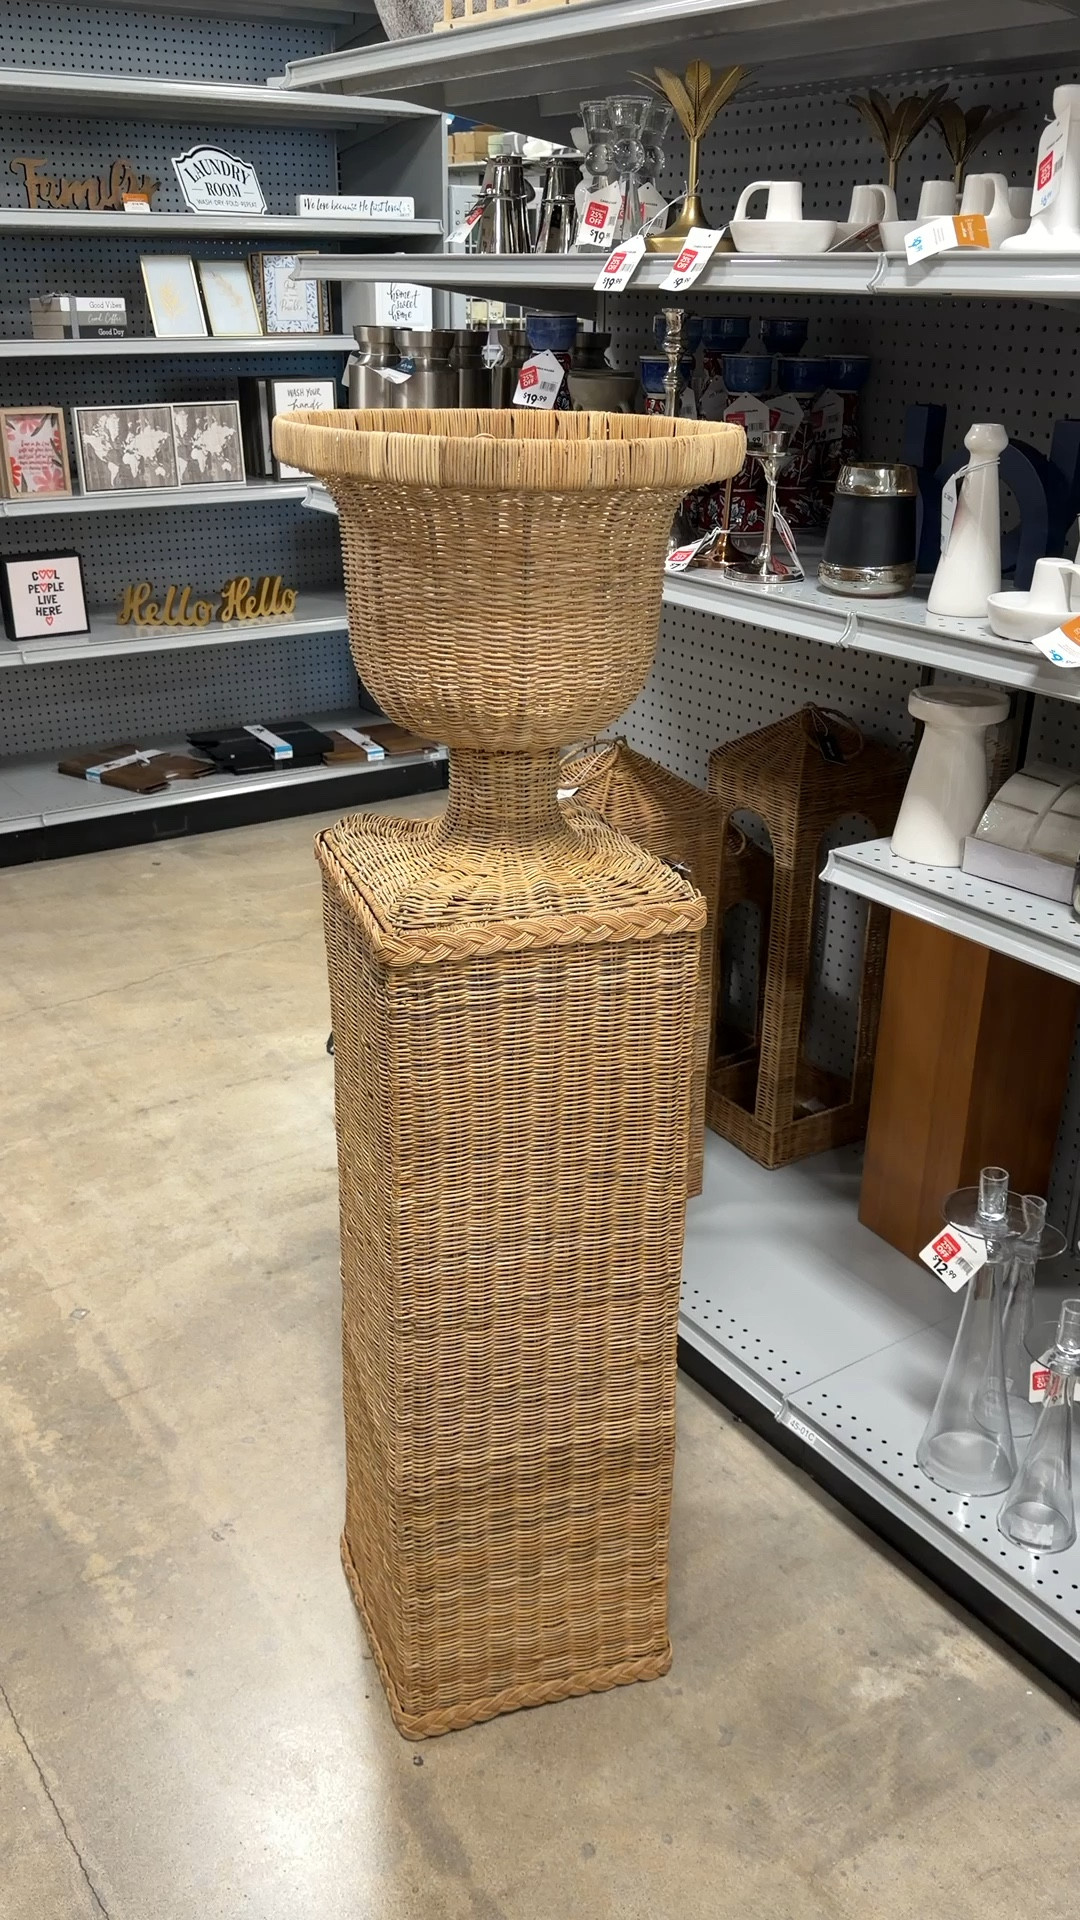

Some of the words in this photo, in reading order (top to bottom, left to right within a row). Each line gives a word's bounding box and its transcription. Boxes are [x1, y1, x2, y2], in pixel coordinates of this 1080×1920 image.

[184, 159, 250, 185] LAUNDRY
[205, 182, 242, 197] ROOM
[303, 198, 315, 210] We
[359, 200, 368, 211] He
[589, 217, 602, 225] OFF
[590, 210, 604, 219] 25%
[387, 282, 413, 302] home
[89, 301, 104, 309] Good
[105, 300, 122, 309] Vibes
[396, 290, 420, 309] sweet
[388, 304, 412, 321] home
[97, 328, 112, 336] Good
[112, 328, 124, 337] Day
[287, 388, 304, 397] WASH
[306, 387, 322, 397] YOUR
[522, 392, 548, 405] $19.99
[287, 399, 323, 410] hands
[37, 594, 58, 605] LIVE
[117, 581, 213, 626] Hello
[220, 575, 298, 622] Hello
[36, 604, 63, 617] HERE
[936, 1245, 950, 1258] OFF
[932, 1254, 957, 1279] $12.99
